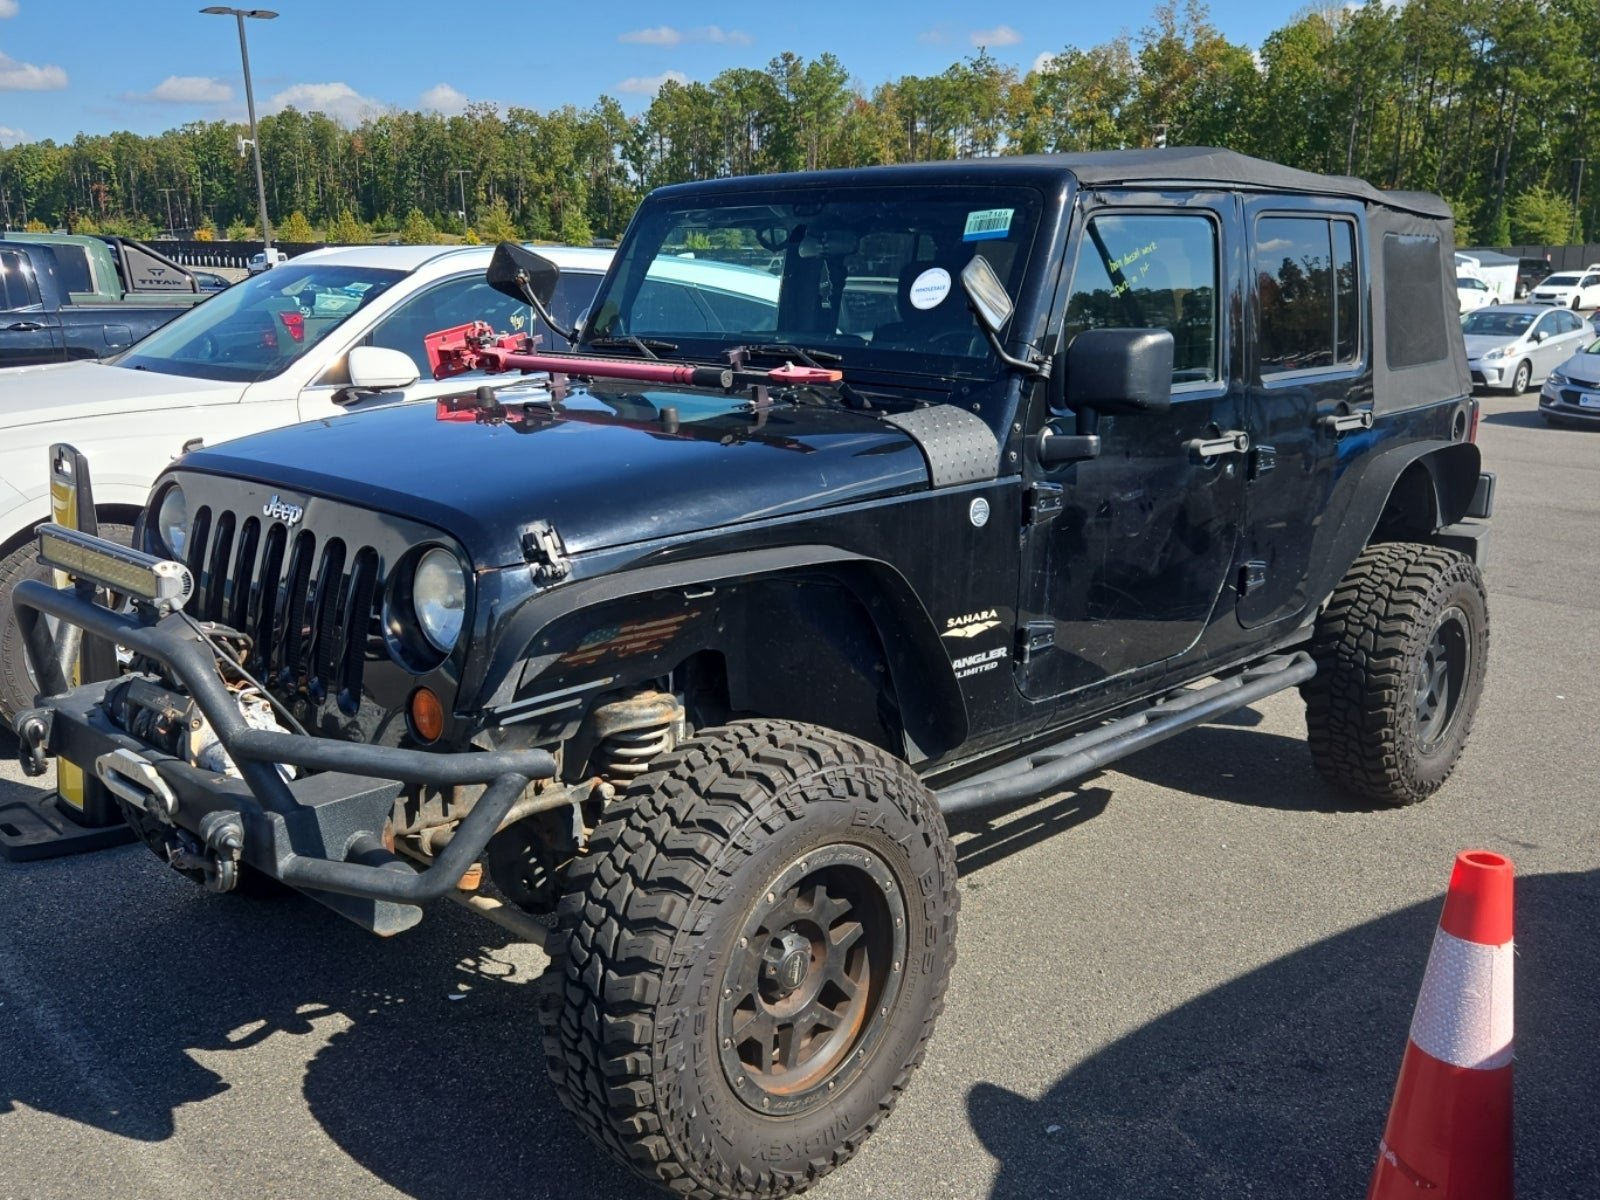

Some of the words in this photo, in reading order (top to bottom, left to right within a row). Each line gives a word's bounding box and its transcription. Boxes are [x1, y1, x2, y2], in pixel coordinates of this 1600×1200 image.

[139, 278, 182, 286] TITAN
[263, 494, 303, 527] Jeep
[947, 609, 998, 628] SAHARA
[955, 661, 998, 678] LIMITED
